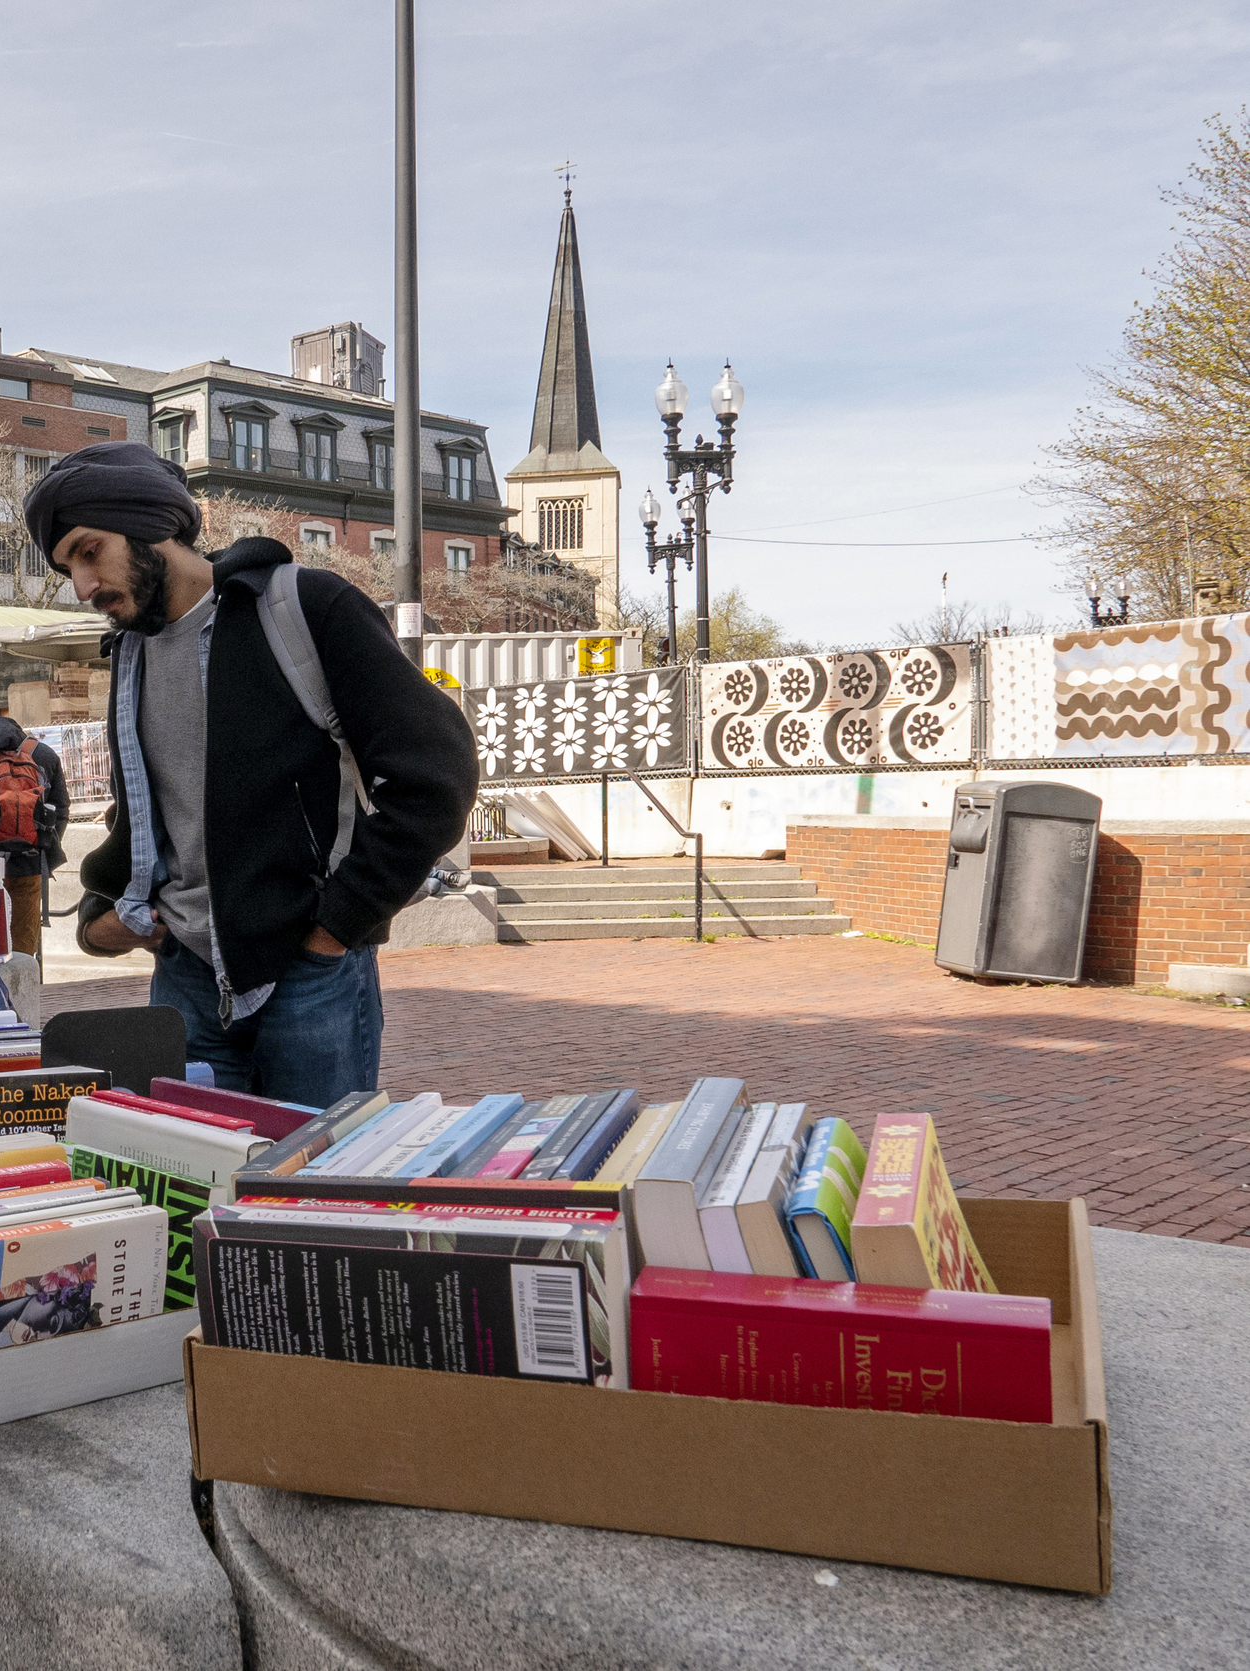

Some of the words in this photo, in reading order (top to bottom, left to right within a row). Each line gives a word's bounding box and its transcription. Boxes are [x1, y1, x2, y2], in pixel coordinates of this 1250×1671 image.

[586, 642, 608, 650] EAGLE
[1070, 849, 1088, 858] ONE
[32, 1082, 97, 1102] Naked
[687, 1103, 715, 1126] EXHIBITING
[8, 1125, 24, 1135] 107
[26, 1124, 52, 1134] Other
[53, 1123, 67, 1132] Iss
[673, 1126, 702, 1150] CULTURES
[73, 1147, 96, 1180] RE
[384, 1149, 414, 1165] URSULA
[4, 1164, 36, 1172] SIXTH
[370, 1165, 396, 1176] HEG
[49, 1180, 91, 1189] PROUST
[76, 1213, 119, 1223] SHIELDS
[119, 1207, 151, 1215] CAROL
[295, 1197, 379, 1209] Boomsday
[420, 1204, 525, 1216] CHRISTOPHER
[526, 1209, 596, 1219] BUCKLEY
[30, 1223, 54, 1231] THE
[155, 1223, 163, 1243] The
[225, 1246, 233, 1258] day
[111, 1239, 127, 1297] STONE
[278, 1274, 288, 1308] storytelling
[302, 1265, 312, 1304] screenwriter
[517, 1280, 525, 1301] $18.50
[128, 1288, 142, 1321] THE
[791, 1289, 849, 1301] Finance
[870, 1295, 949, 1309] Dictionary
[109, 1304, 123, 1324] DI
[283, 1318, 293, 1353] masterpiece
[316, 1317, 325, 1350] California,
[520, 1322, 528, 1342] $15.99
[522, 1344, 530, 1358] USD
[649, 1337, 661, 1368] Jordan
[736, 1337, 745, 1364] recent
[746, 1330, 759, 1368] Explains
[852, 1332, 880, 1411] Invest
[885, 1368, 913, 1413] Fin
[919, 1366, 946, 1416] Dict
